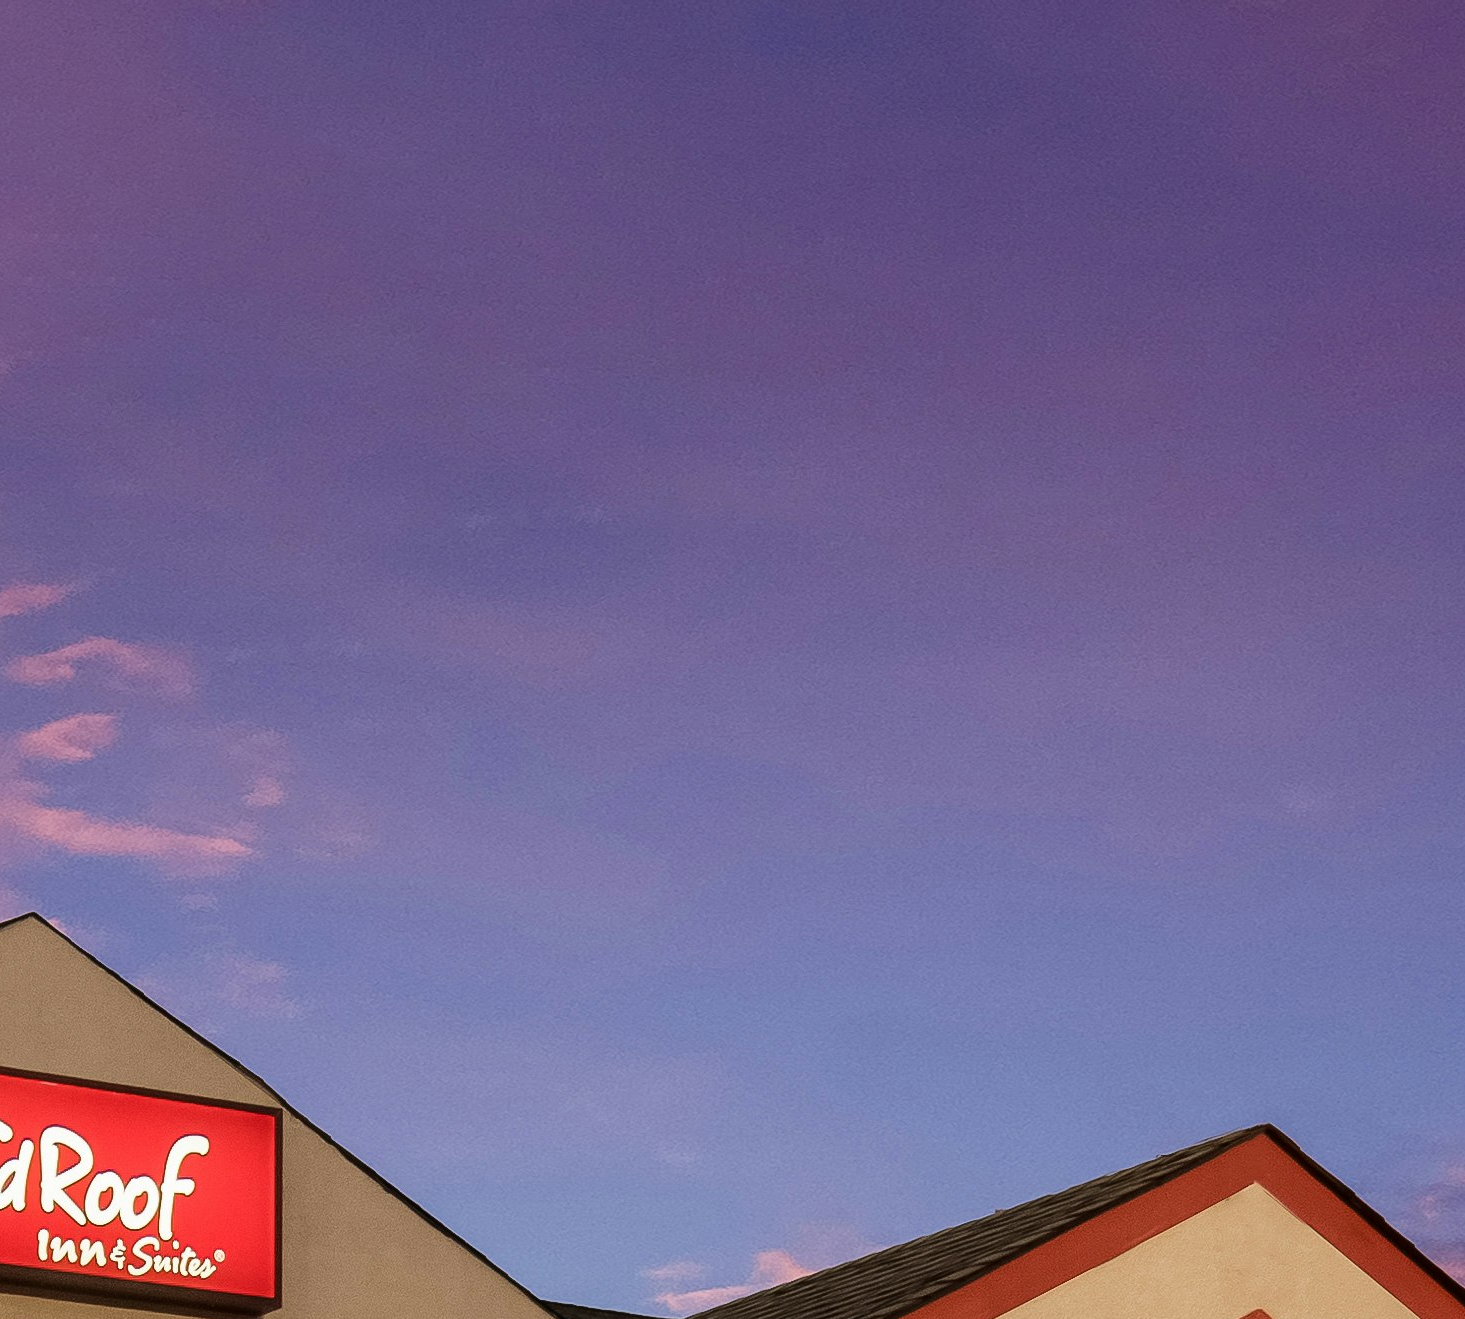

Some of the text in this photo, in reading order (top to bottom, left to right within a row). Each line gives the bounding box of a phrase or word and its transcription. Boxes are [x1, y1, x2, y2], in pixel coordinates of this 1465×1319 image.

[39, 1124, 210, 1241] Roof
[37, 1228, 108, 1268] Inn
[109, 1238, 127, 1270] &
